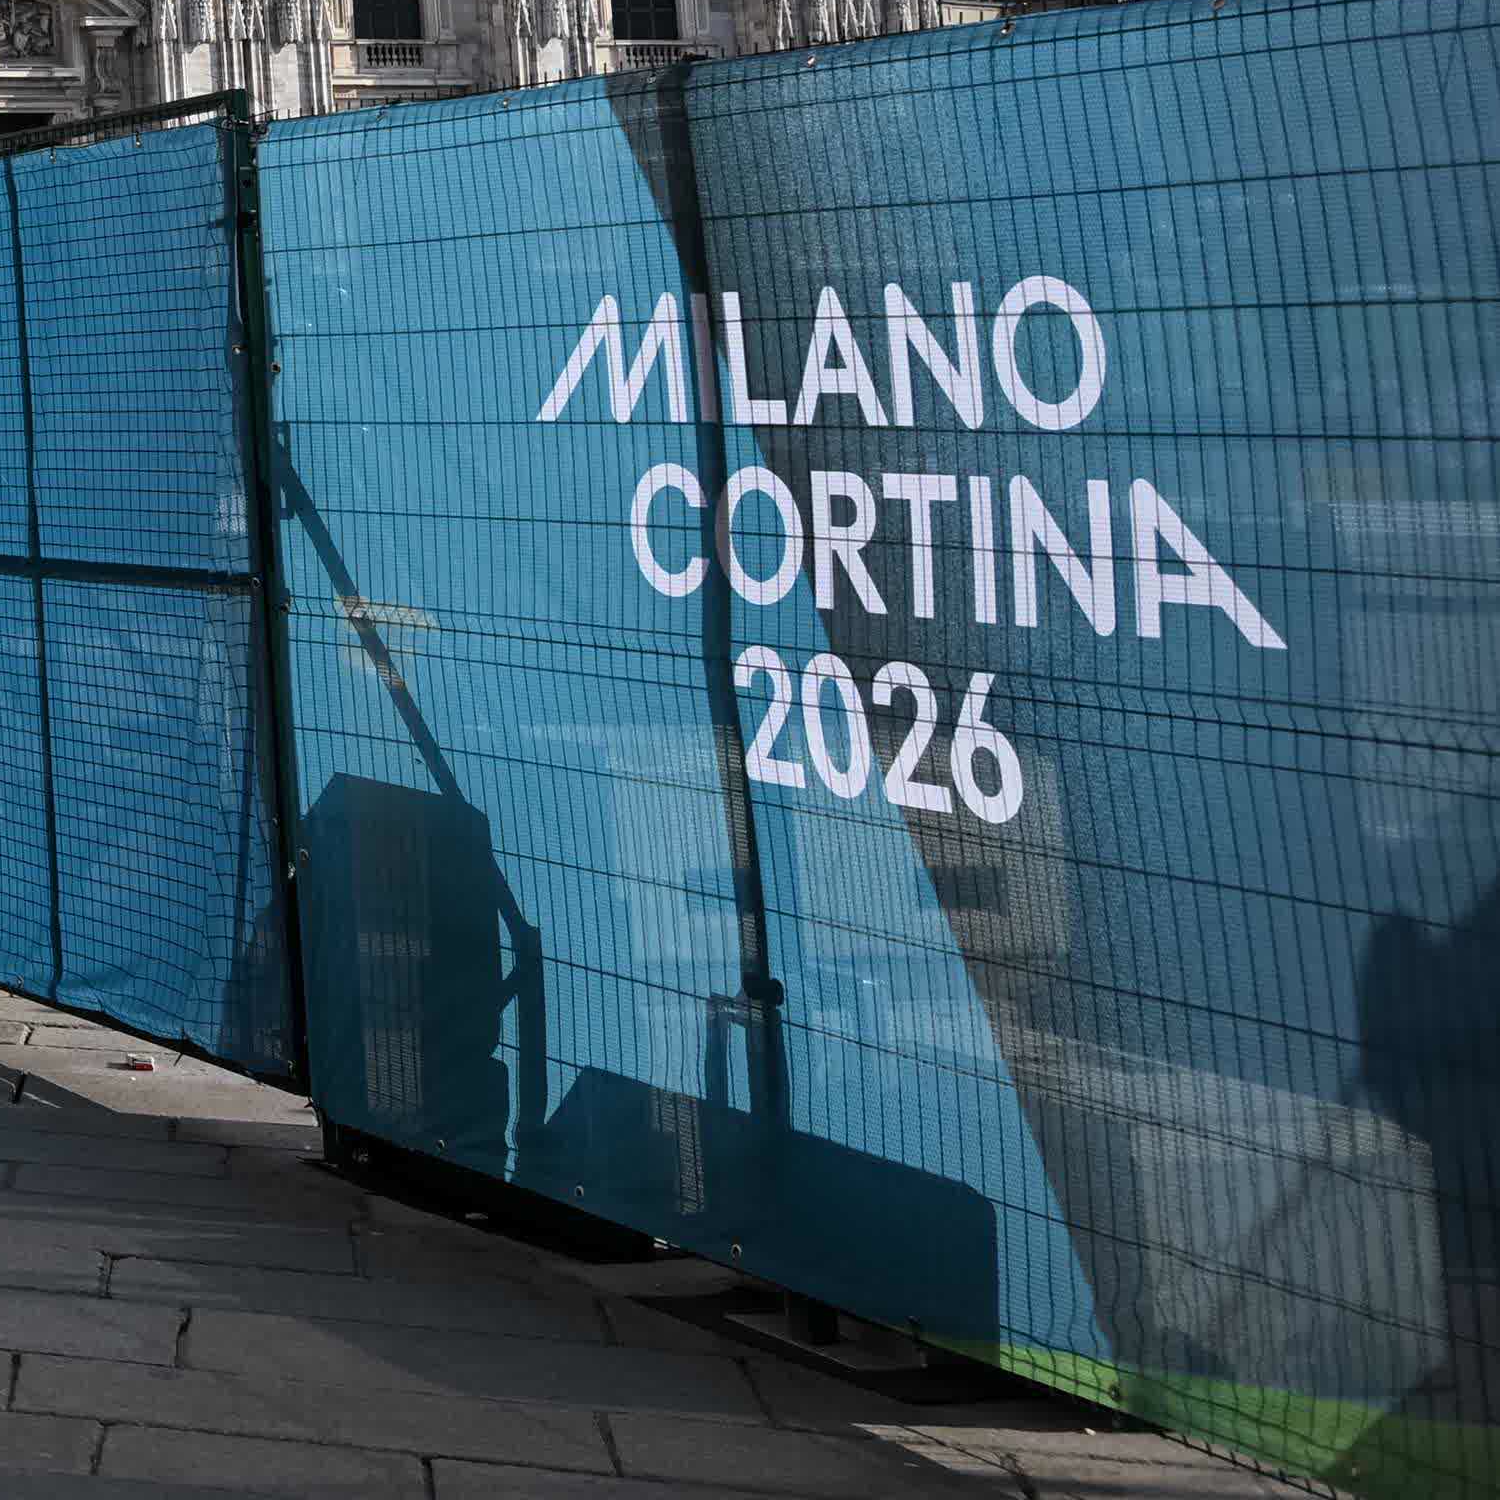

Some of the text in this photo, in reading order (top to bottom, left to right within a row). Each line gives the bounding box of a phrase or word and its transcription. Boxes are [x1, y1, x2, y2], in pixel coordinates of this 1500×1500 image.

[535, 275, 1106, 431] MILANO
[629, 463, 1287, 650] CORTINA
[732, 644, 1024, 824] 2026
